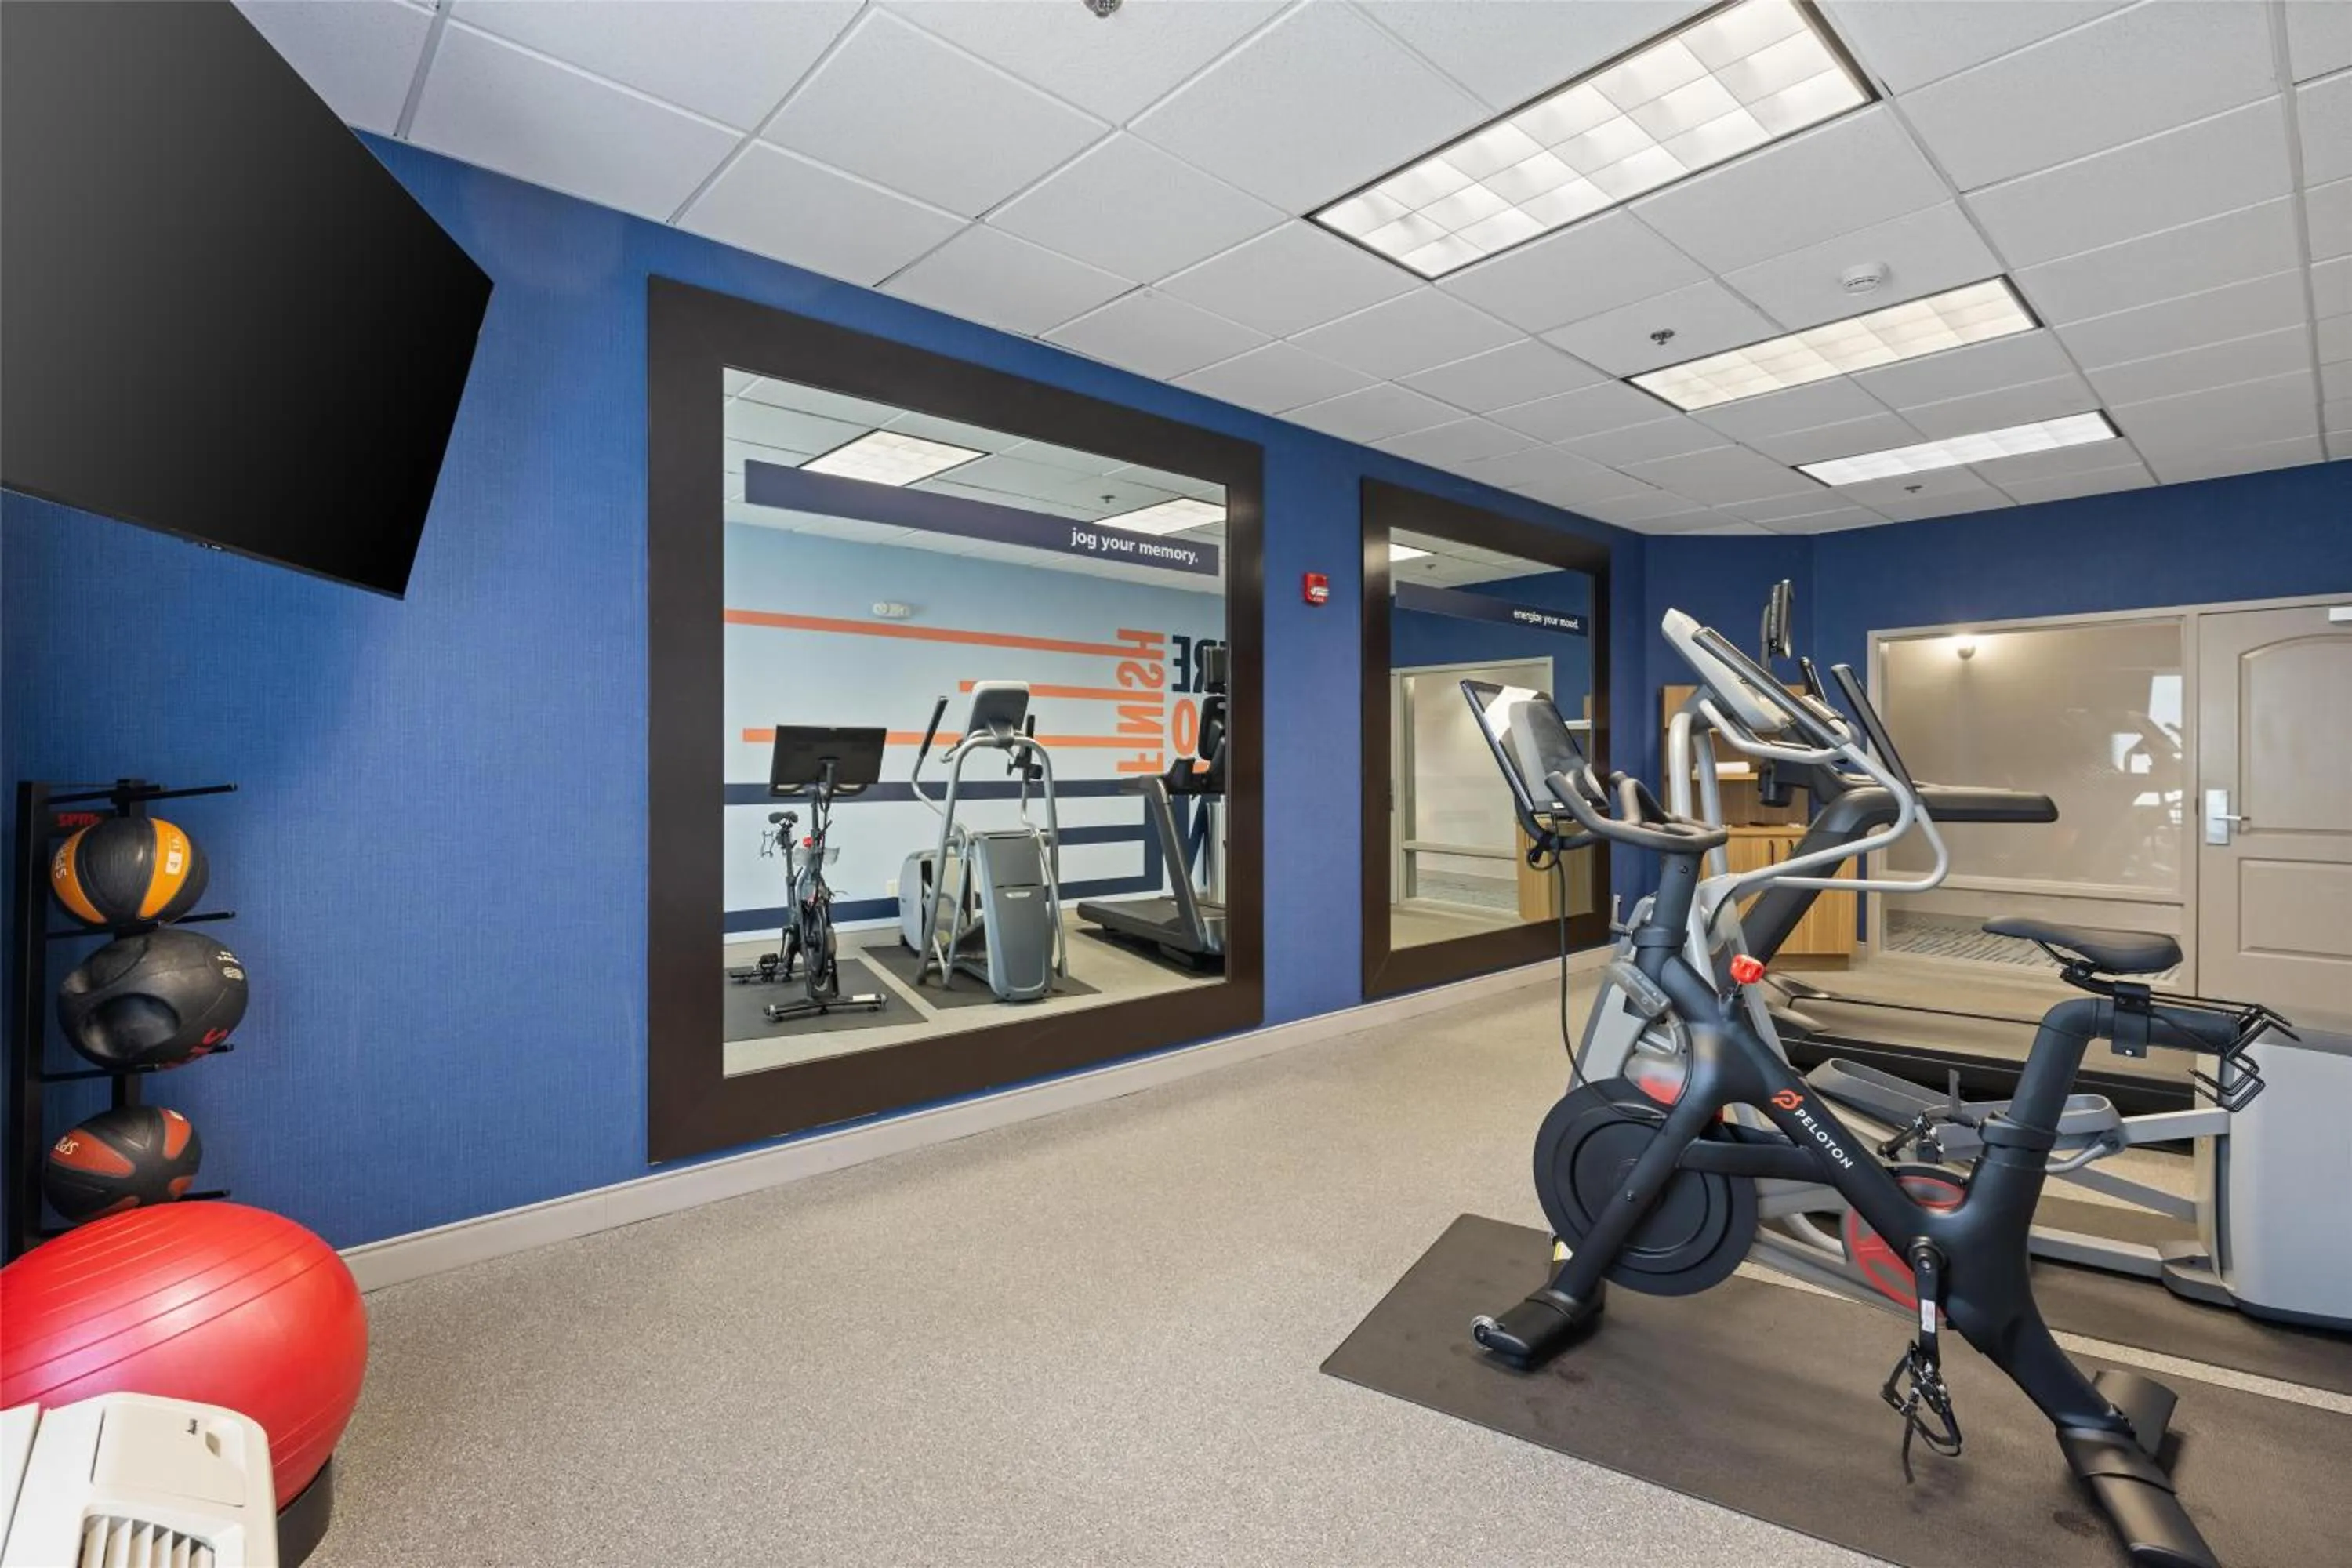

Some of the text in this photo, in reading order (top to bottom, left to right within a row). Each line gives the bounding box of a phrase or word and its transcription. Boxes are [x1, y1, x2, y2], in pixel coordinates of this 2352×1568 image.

[1071, 527, 1198, 564] jog your memory.
[1794, 1108, 1853, 1169] PELOTON
